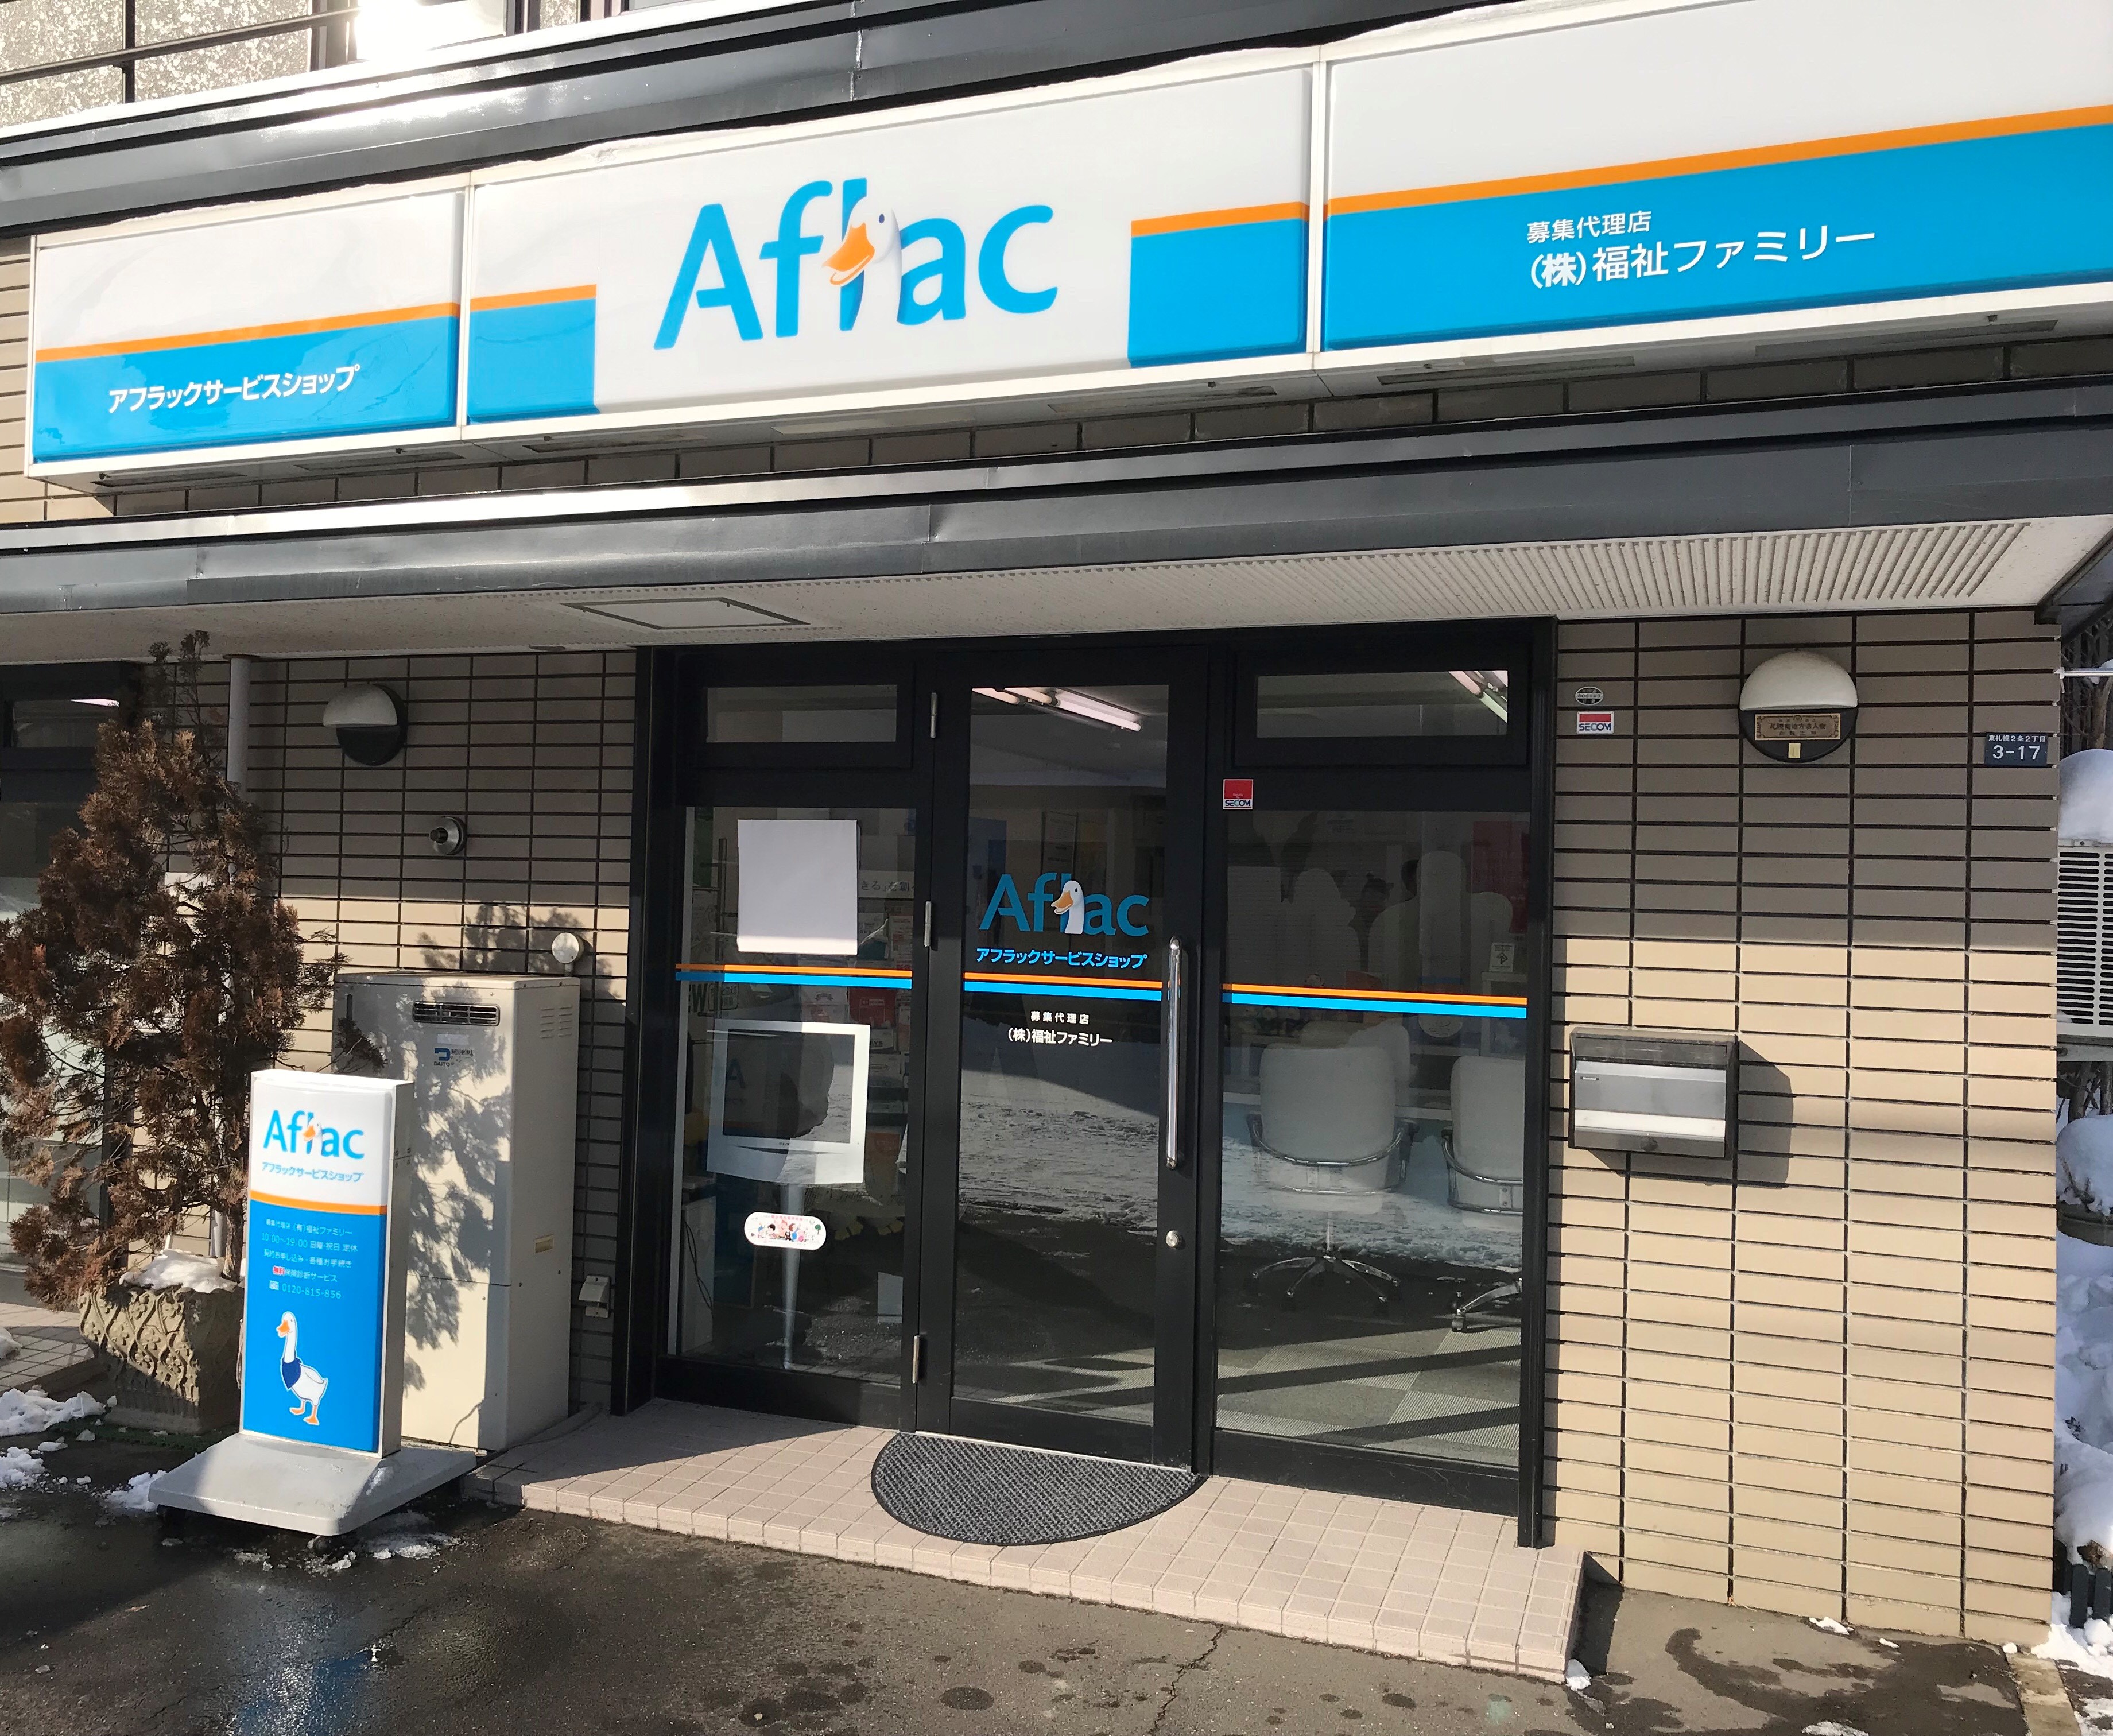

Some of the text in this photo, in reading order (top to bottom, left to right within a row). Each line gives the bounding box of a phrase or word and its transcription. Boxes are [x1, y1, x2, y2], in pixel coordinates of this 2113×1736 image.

[1527, 211, 1651, 243] 募集代理店
[1530, 225, 1875, 289] (株)福祉ファミリー
[109, 363, 360, 413] アフラックサービスショップ
[1579, 723, 1612, 731] SECOM
[1992, 745, 2040, 760] 3-17
[976, 948, 1147, 969] アフラックサービスショップ
[1030, 1010, 1089, 1025] 募集代理店
[1007, 1027, 1112, 1047] (株)福祉ファミリー
[262, 1161, 365, 1183] アフラックサービスショップ
[282, 1283, 342, 1299] 0120-815-856
